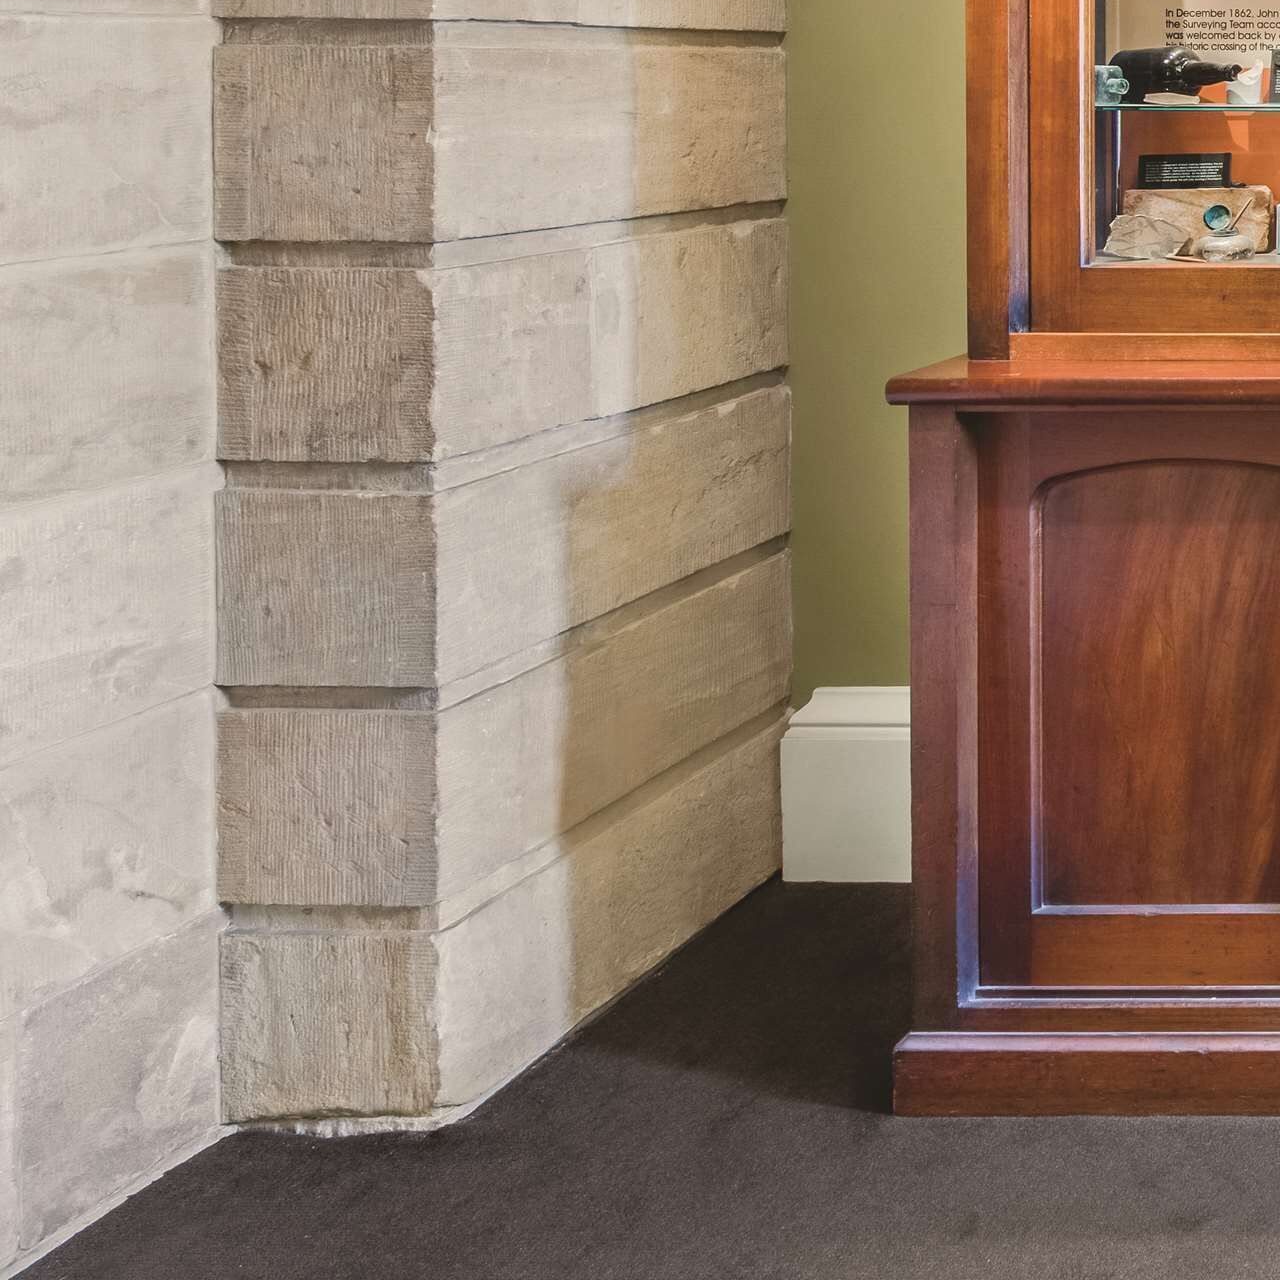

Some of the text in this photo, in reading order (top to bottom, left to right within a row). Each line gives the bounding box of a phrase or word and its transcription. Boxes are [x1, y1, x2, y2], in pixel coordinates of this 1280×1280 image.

[1165, 9, 1174, 18] In
[1175, 9, 1226, 18] December
[1256, 9, 1279, 18] John
